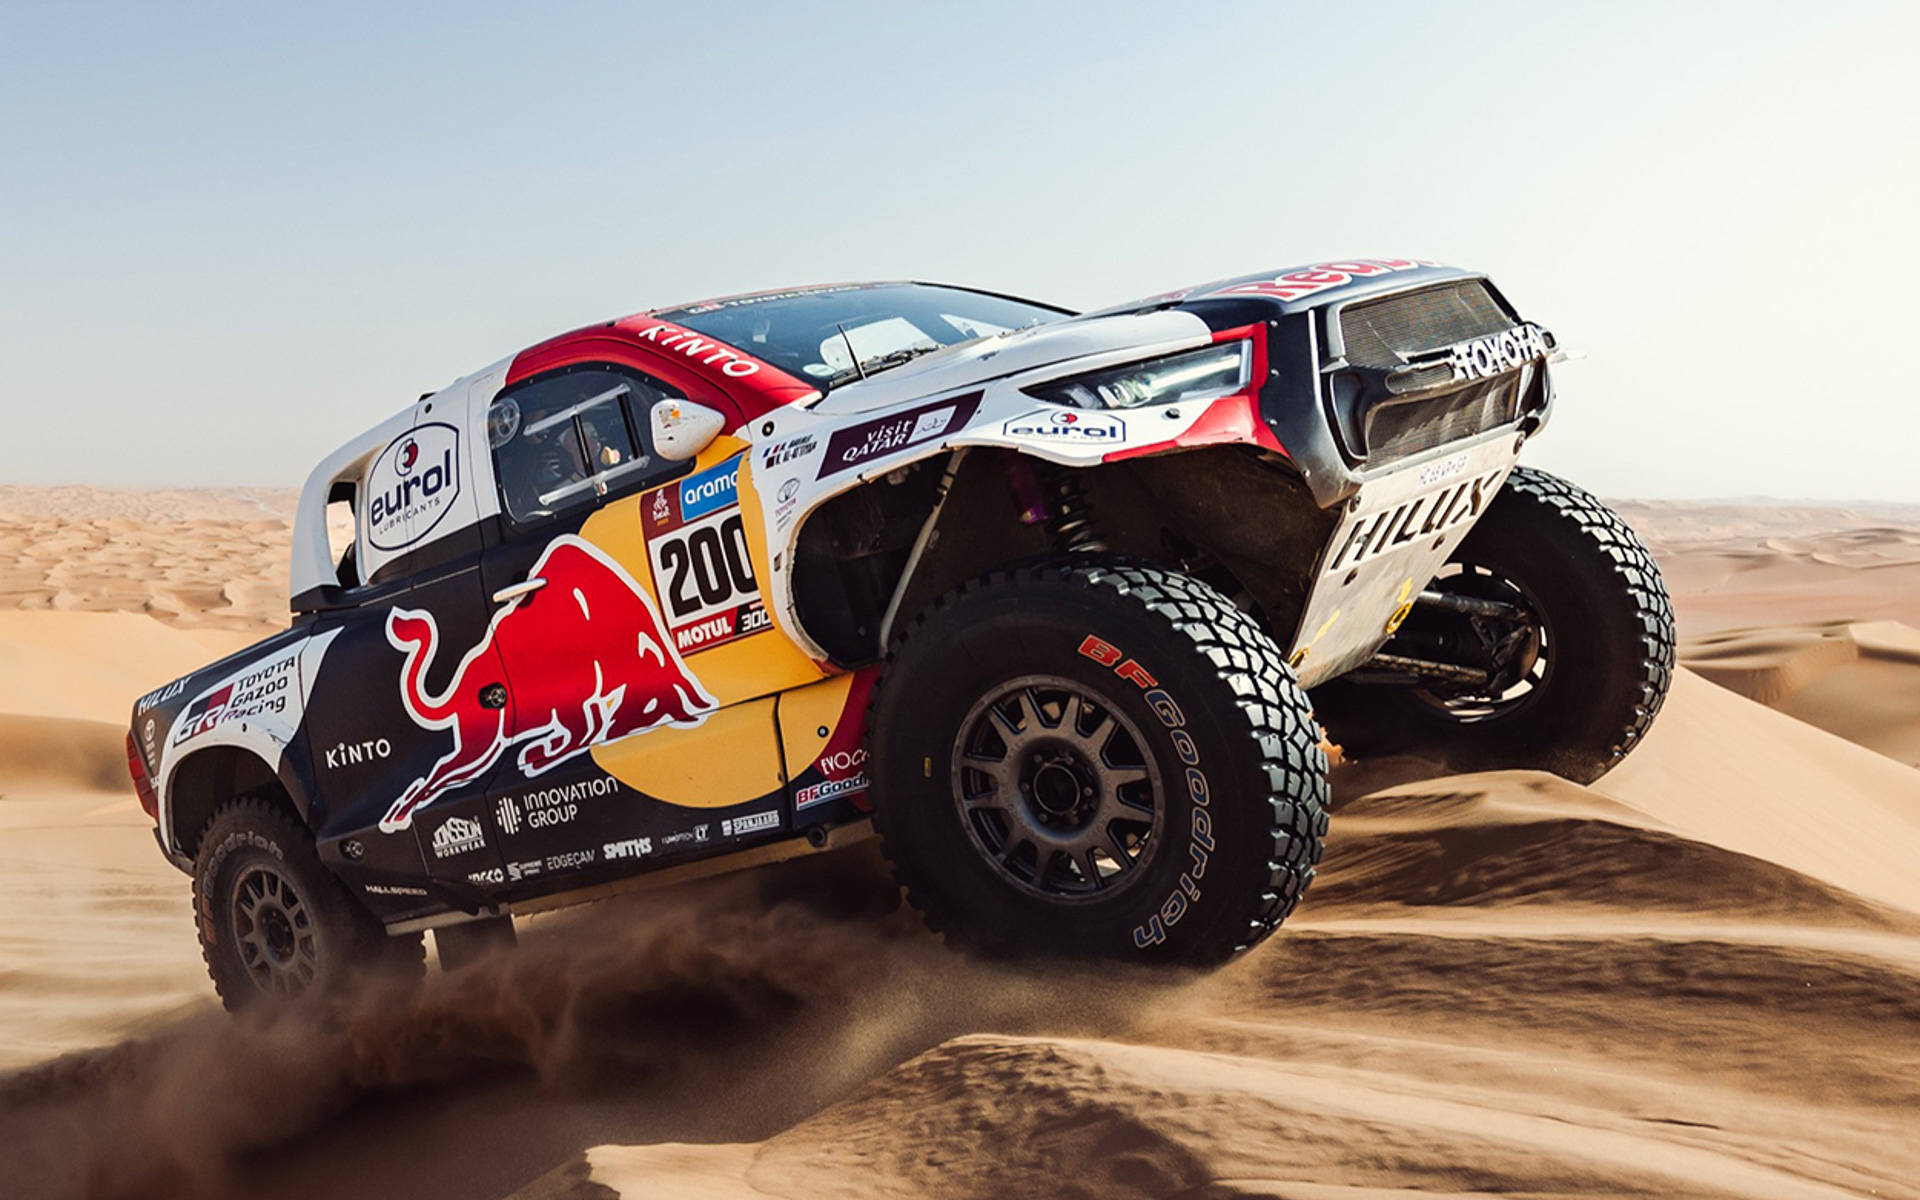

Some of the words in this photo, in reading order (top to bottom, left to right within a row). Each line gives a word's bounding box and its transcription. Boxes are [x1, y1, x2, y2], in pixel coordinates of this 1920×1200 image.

[1453, 325, 1546, 380] TOYOTA
[842, 433, 910, 462] QATAR
[866, 420, 913, 443] visit
[1012, 425, 1117, 438] eurol
[371, 448, 451, 527] eurol
[379, 496, 441, 535] LUBRICANTS
[1329, 470, 1502, 571] HILUX
[660, 513, 759, 619] 200
[677, 616, 733, 649] MOTUL
[238, 656, 296, 692] TOYOTA
[138, 675, 192, 717] HILUX
[230, 676, 289, 709] GAZOO
[221, 695, 287, 724] Racing
[523, 776, 619, 811] INNOVATION
[1077, 633, 1216, 949] BFGoodrich
[432, 816, 483, 848] JONSSON
[527, 803, 579, 829] GROUP
[435, 839, 486, 859] WORKWEAR
[547, 849, 595, 871] EDGECAM
[603, 836, 653, 860] SMITHS
